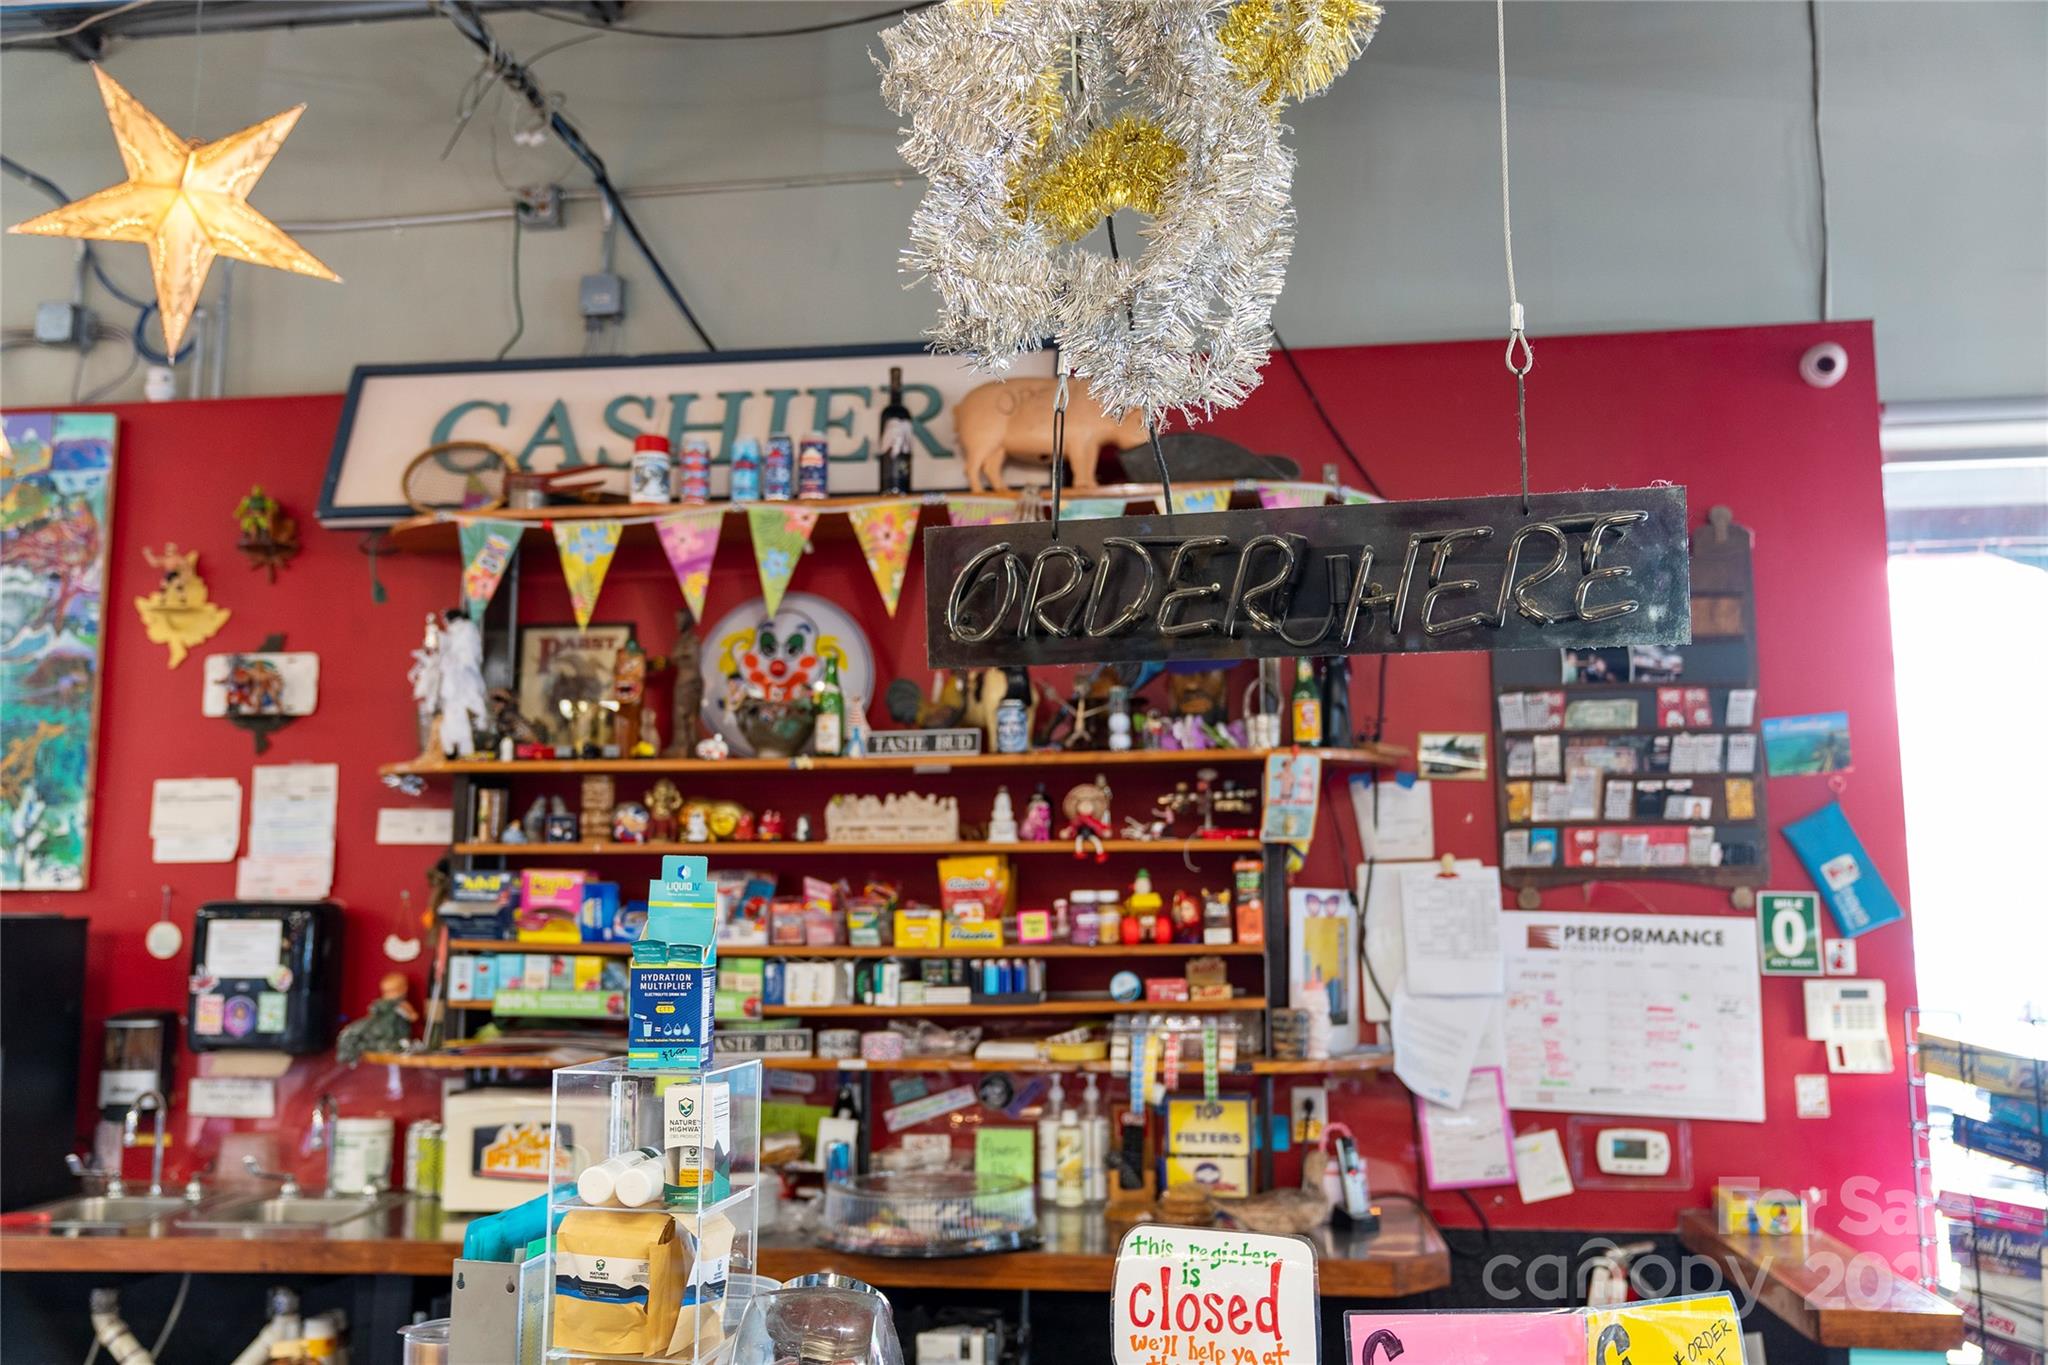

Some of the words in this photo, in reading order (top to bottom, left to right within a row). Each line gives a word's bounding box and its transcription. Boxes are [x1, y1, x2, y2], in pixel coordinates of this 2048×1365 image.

[430, 383, 956, 475] CASHIER
[945, 533, 1300, 646] ORDER
[1344, 509, 1649, 646] HERE
[935, 734, 974, 750] BUD
[666, 881, 692, 892] LIQUID
[1564, 925, 1725, 947] PERFORMANCE
[1771, 908, 1807, 958] 0
[640, 973, 692, 982] HYDRATION
[764, 1033, 805, 1052] BUD
[1195, 1104, 1224, 1119] TOP
[1175, 1131, 1242, 1144] FILTERS
[1129, 1234, 1174, 1257] this
[1188, 1241, 1278, 1270] register
[1181, 1261, 1202, 1287] is
[1129, 1334, 1178, 1357] we'll
[1188, 1334, 1227, 1362] help
[1231, 1346, 1258, 1365] ya
[1262, 1342, 1291, 1365] at
[1687, 1319, 1733, 1362] ORDER
